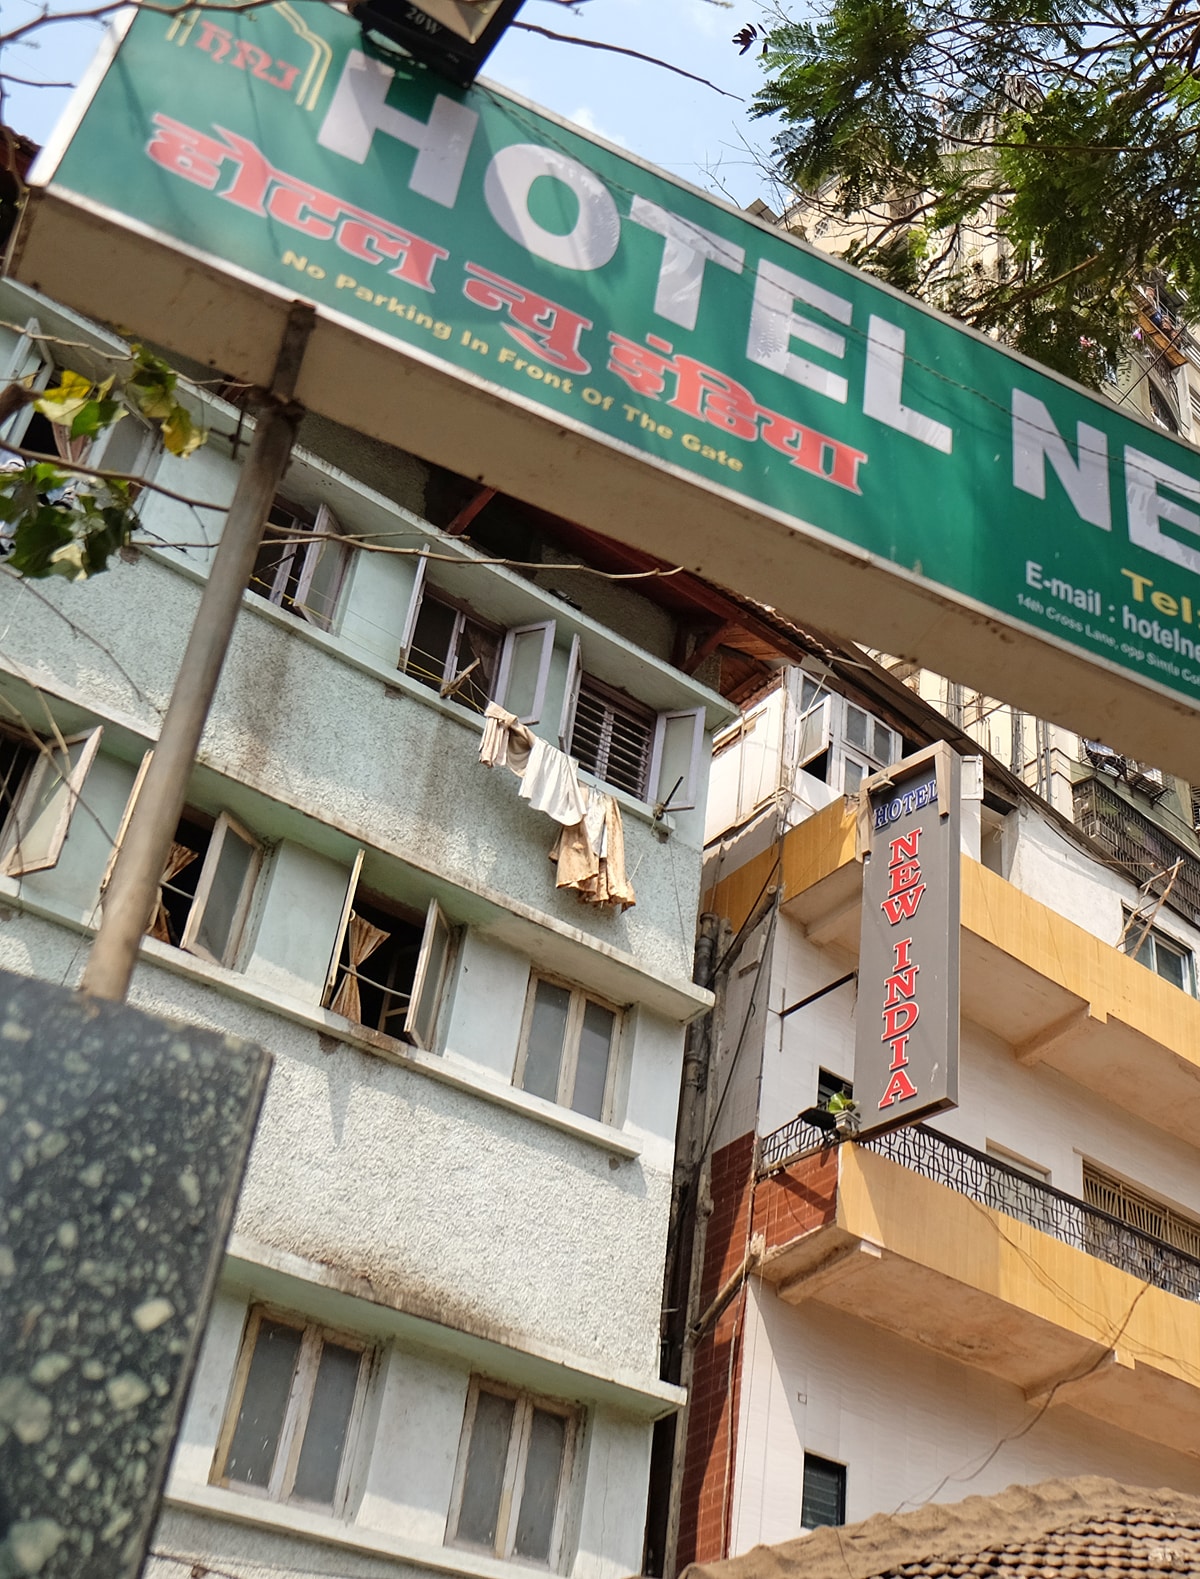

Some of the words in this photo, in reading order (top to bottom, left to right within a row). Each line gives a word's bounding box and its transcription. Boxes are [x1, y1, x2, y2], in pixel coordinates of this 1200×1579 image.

[405, 7, 443, 35] 20W
[317, 48, 953, 455] HOTEL
[146, 112, 449, 293] होटल
[605, 330, 868, 496] इंडिया
[281, 249, 326, 281] No
[335, 273, 453, 342] Parking
[460, 330, 490, 356] In
[498, 348, 575, 395] Front
[581, 386, 615, 412] Of
[622, 403, 674, 441] The
[681, 432, 744, 473] Gate
[1025, 560, 1101, 617] E-mail
[1046, 607, 1083, 633] Cross
[1085, 624, 1120, 650] Lane,
[873, 779, 939, 830] HOTEL
[880, 826, 926, 926] NEW
[877, 936, 920, 1110] INDIA
